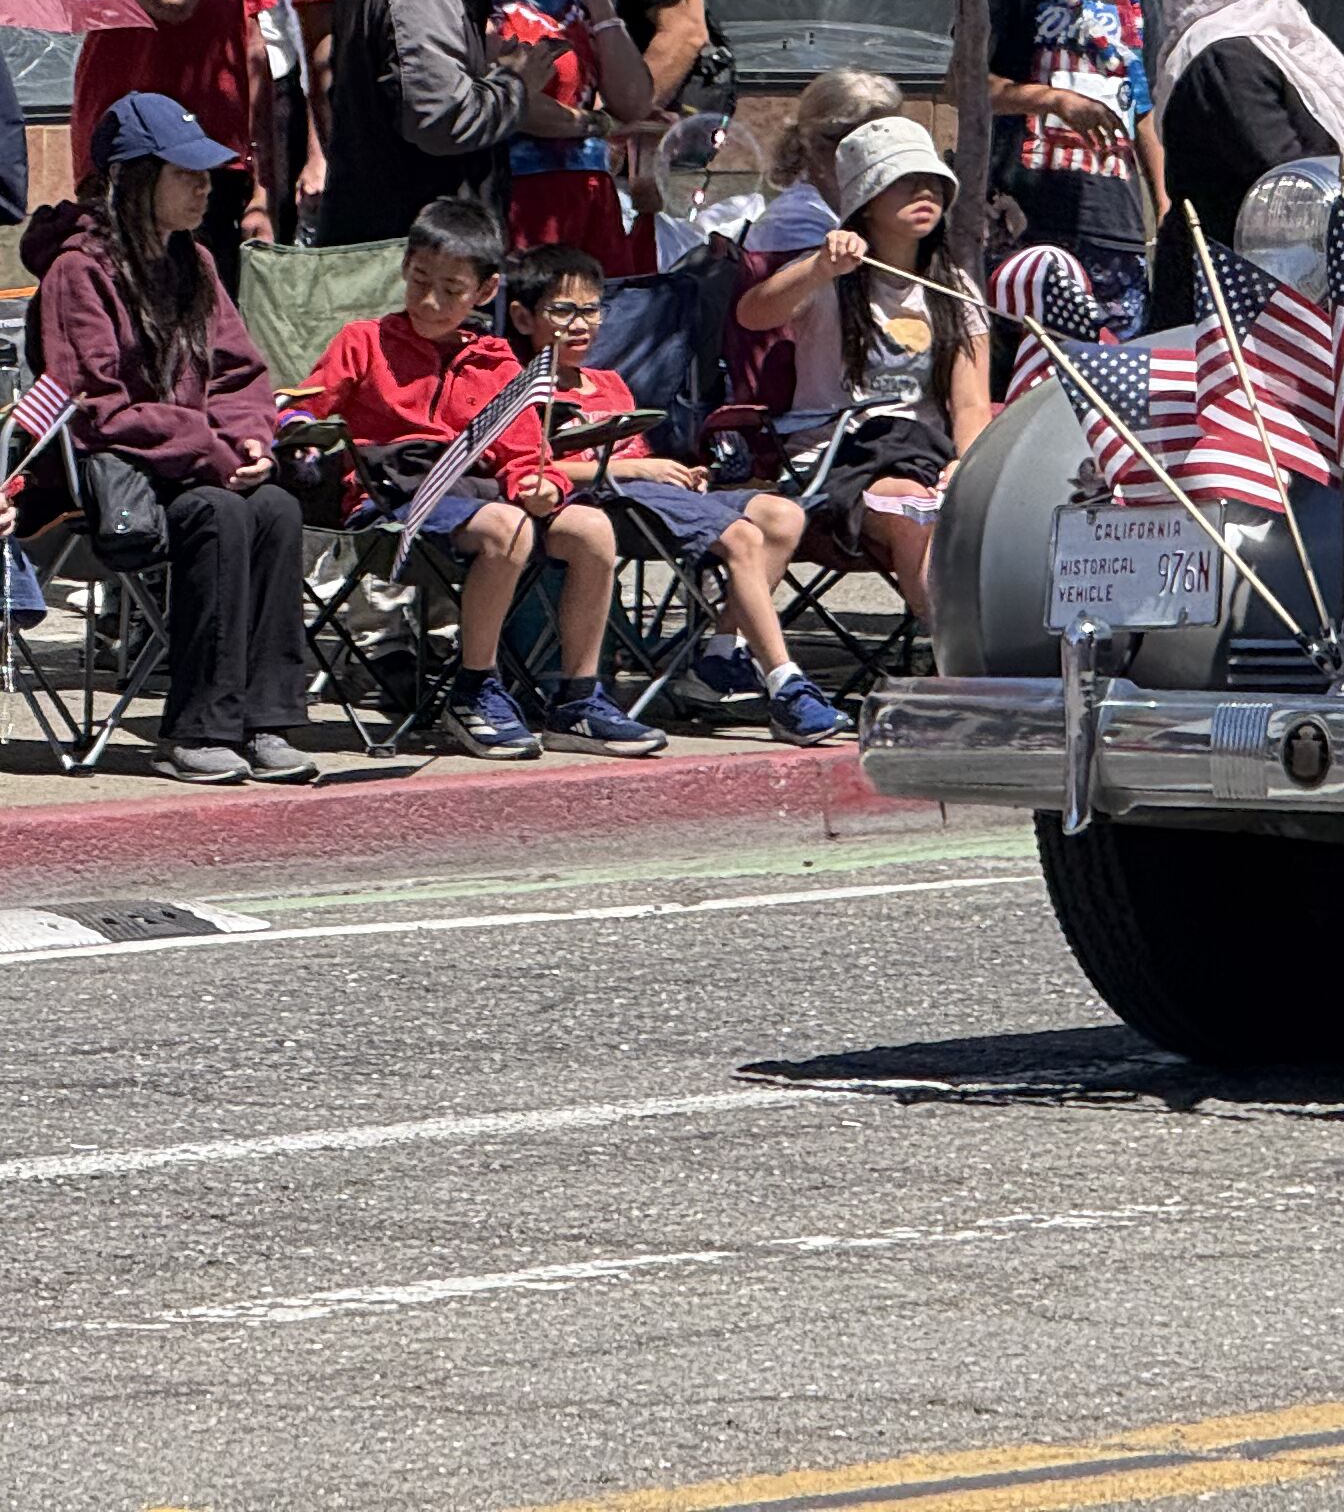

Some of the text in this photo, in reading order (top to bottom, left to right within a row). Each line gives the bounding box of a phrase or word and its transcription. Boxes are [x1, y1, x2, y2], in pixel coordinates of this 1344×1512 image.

[1094, 520, 1181, 541] CALIFORNIA
[1059, 556, 1136, 576] HISTORICAL
[1158, 549, 1212, 597] 976N
[1058, 584, 1114, 603] VEHICLE
